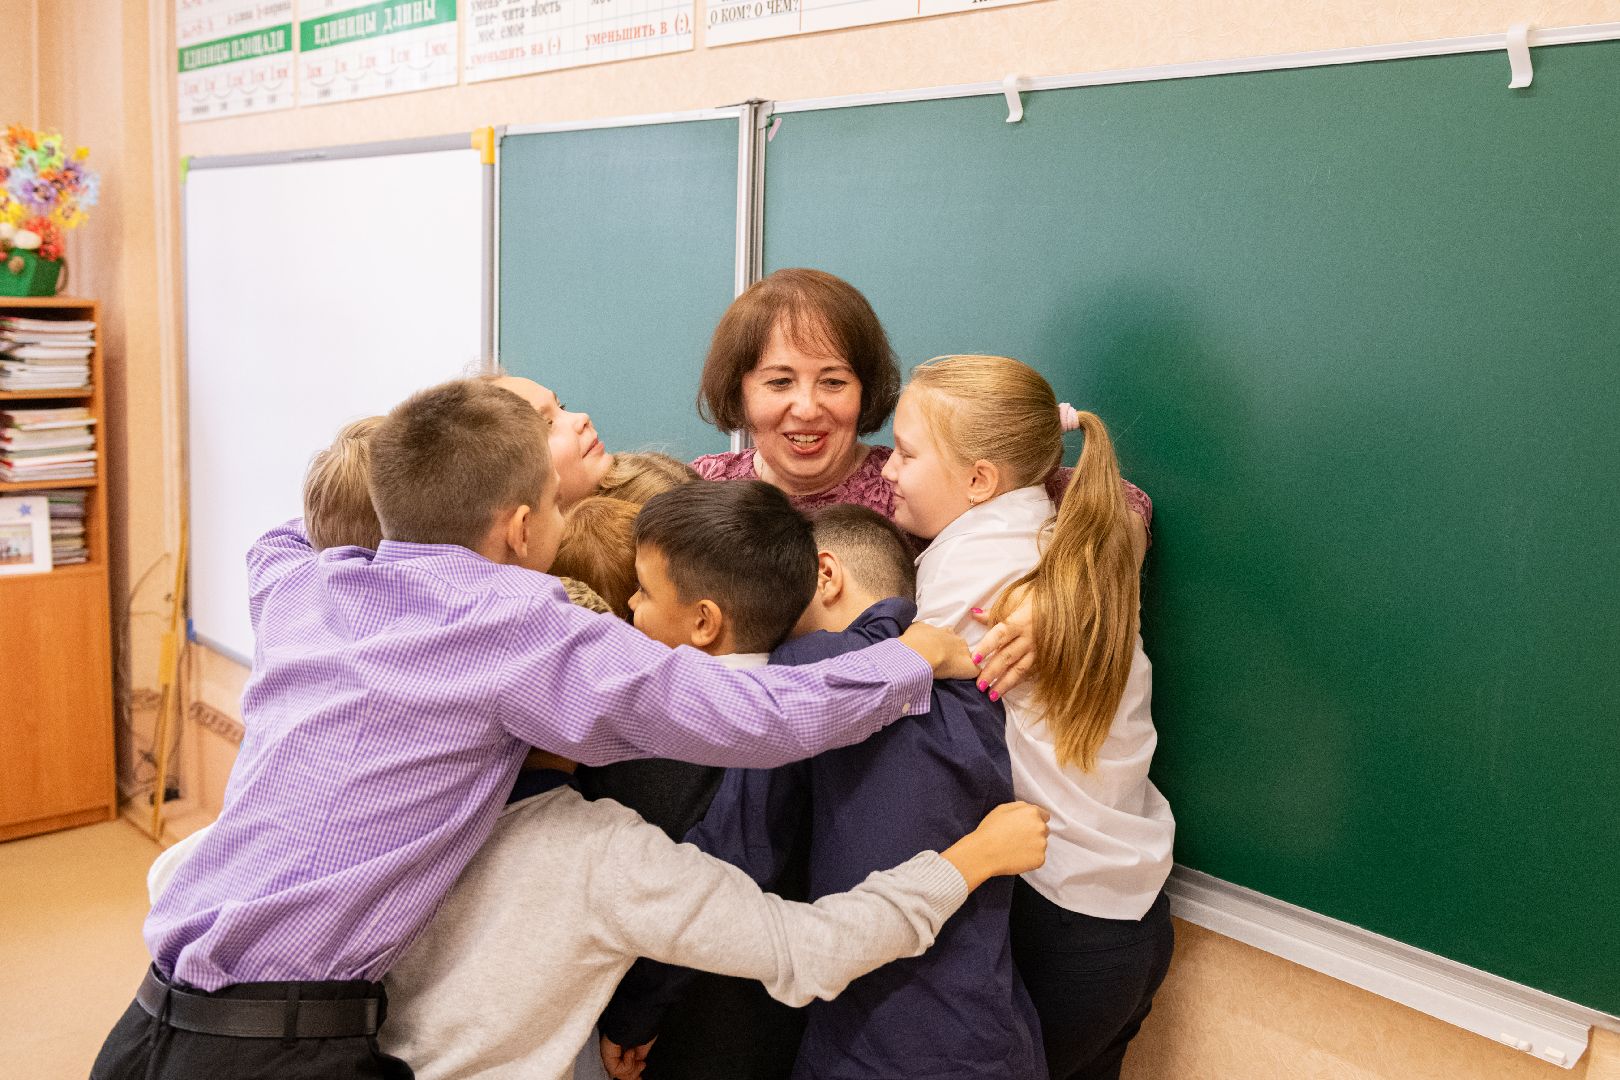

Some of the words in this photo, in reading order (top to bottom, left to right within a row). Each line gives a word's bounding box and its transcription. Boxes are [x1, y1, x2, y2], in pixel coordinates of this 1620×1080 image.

[313, 11, 377, 47] ЕДИНИЦЫ
[382, 0, 437, 33] ДЛИНЫ
[710, 9, 718, 25] О
[721, 4, 752, 23] КОМ?
[754, 2, 763, 17] О
[767, 0, 799, 15] ЧЕМ?
[584, 23, 656, 51] уменьшить
[659, 21, 668, 35] в
